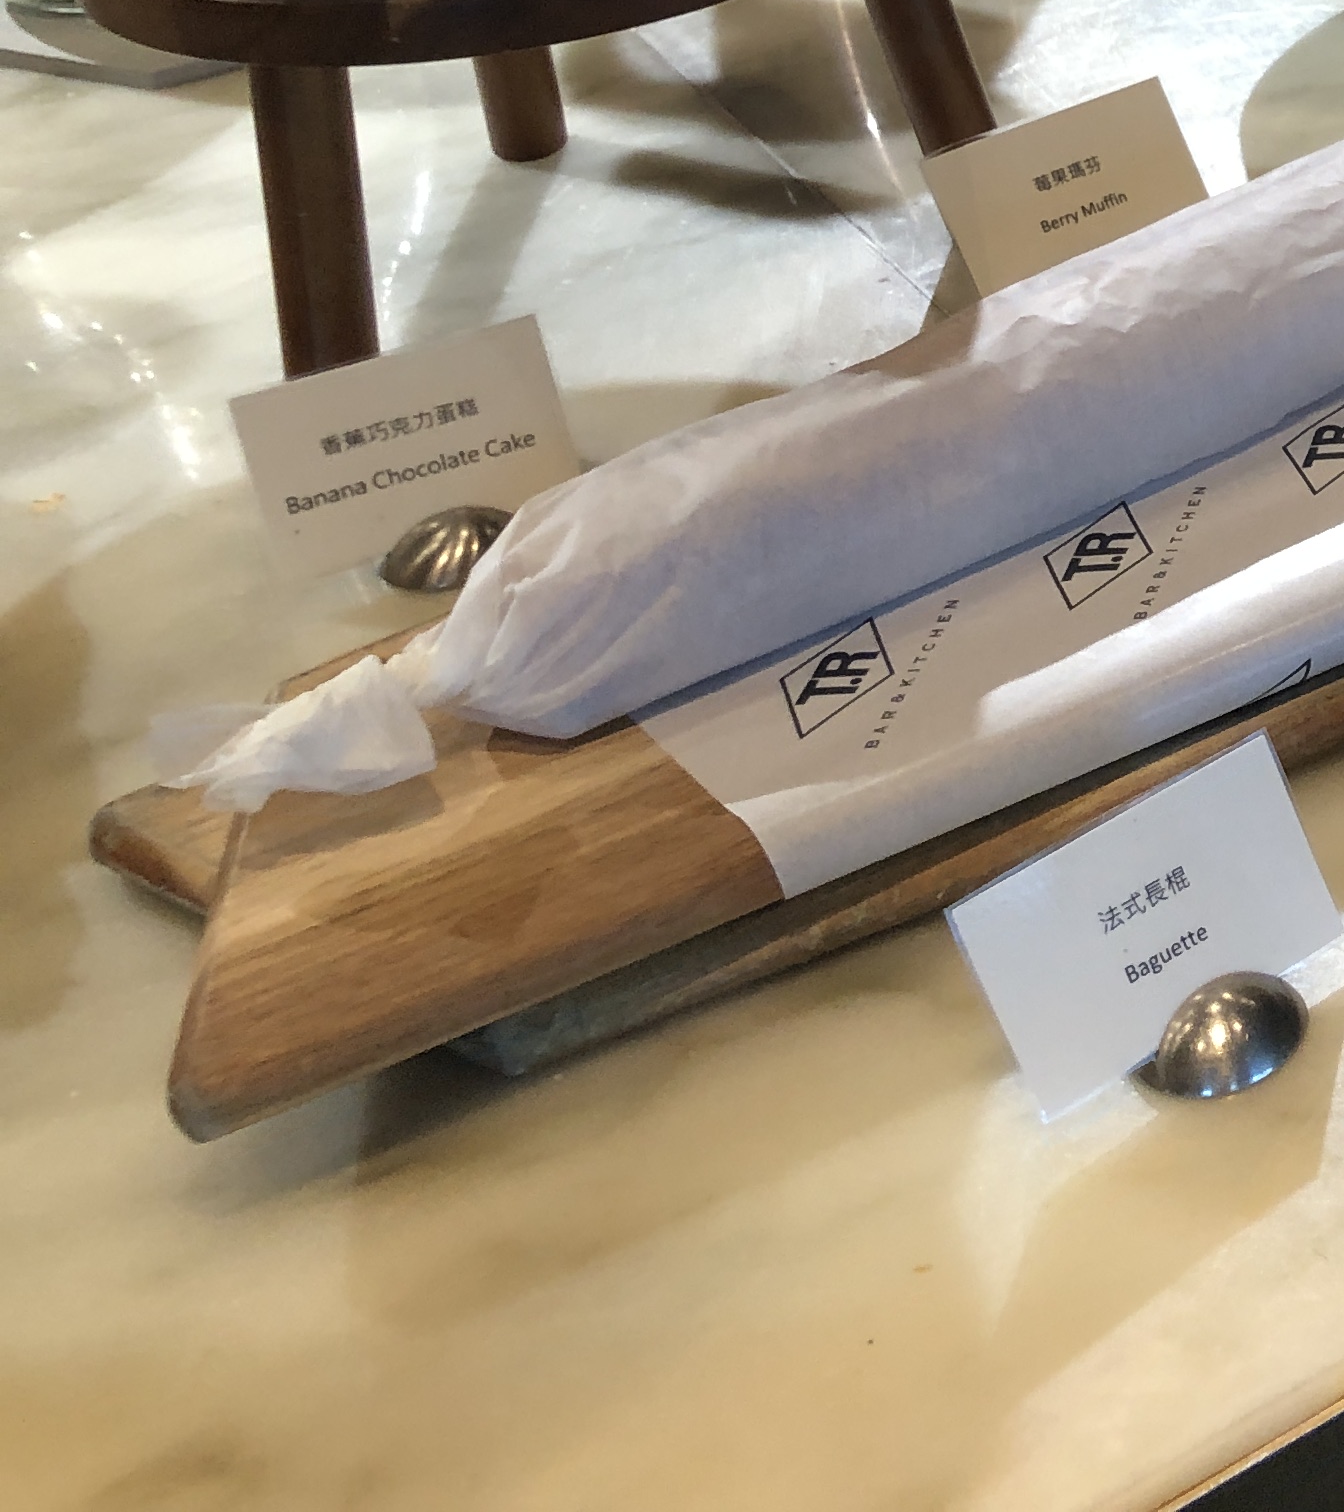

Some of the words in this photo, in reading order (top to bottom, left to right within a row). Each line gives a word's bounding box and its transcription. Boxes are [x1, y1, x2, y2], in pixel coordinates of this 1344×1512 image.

[1032, 155, 1101, 192] 莓果瑪芬
[1040, 211, 1079, 234] Berry
[1080, 192, 1128, 218] Muffin
[320, 397, 480, 456] 香蕉巧克力蛋糕
[284, 480, 368, 515] Banana
[371, 447, 481, 489] Chocolate
[484, 432, 536, 458] Cake
[1097, 865, 1191, 935] 法式長棍
[1124, 926, 1209, 984] Baguette
